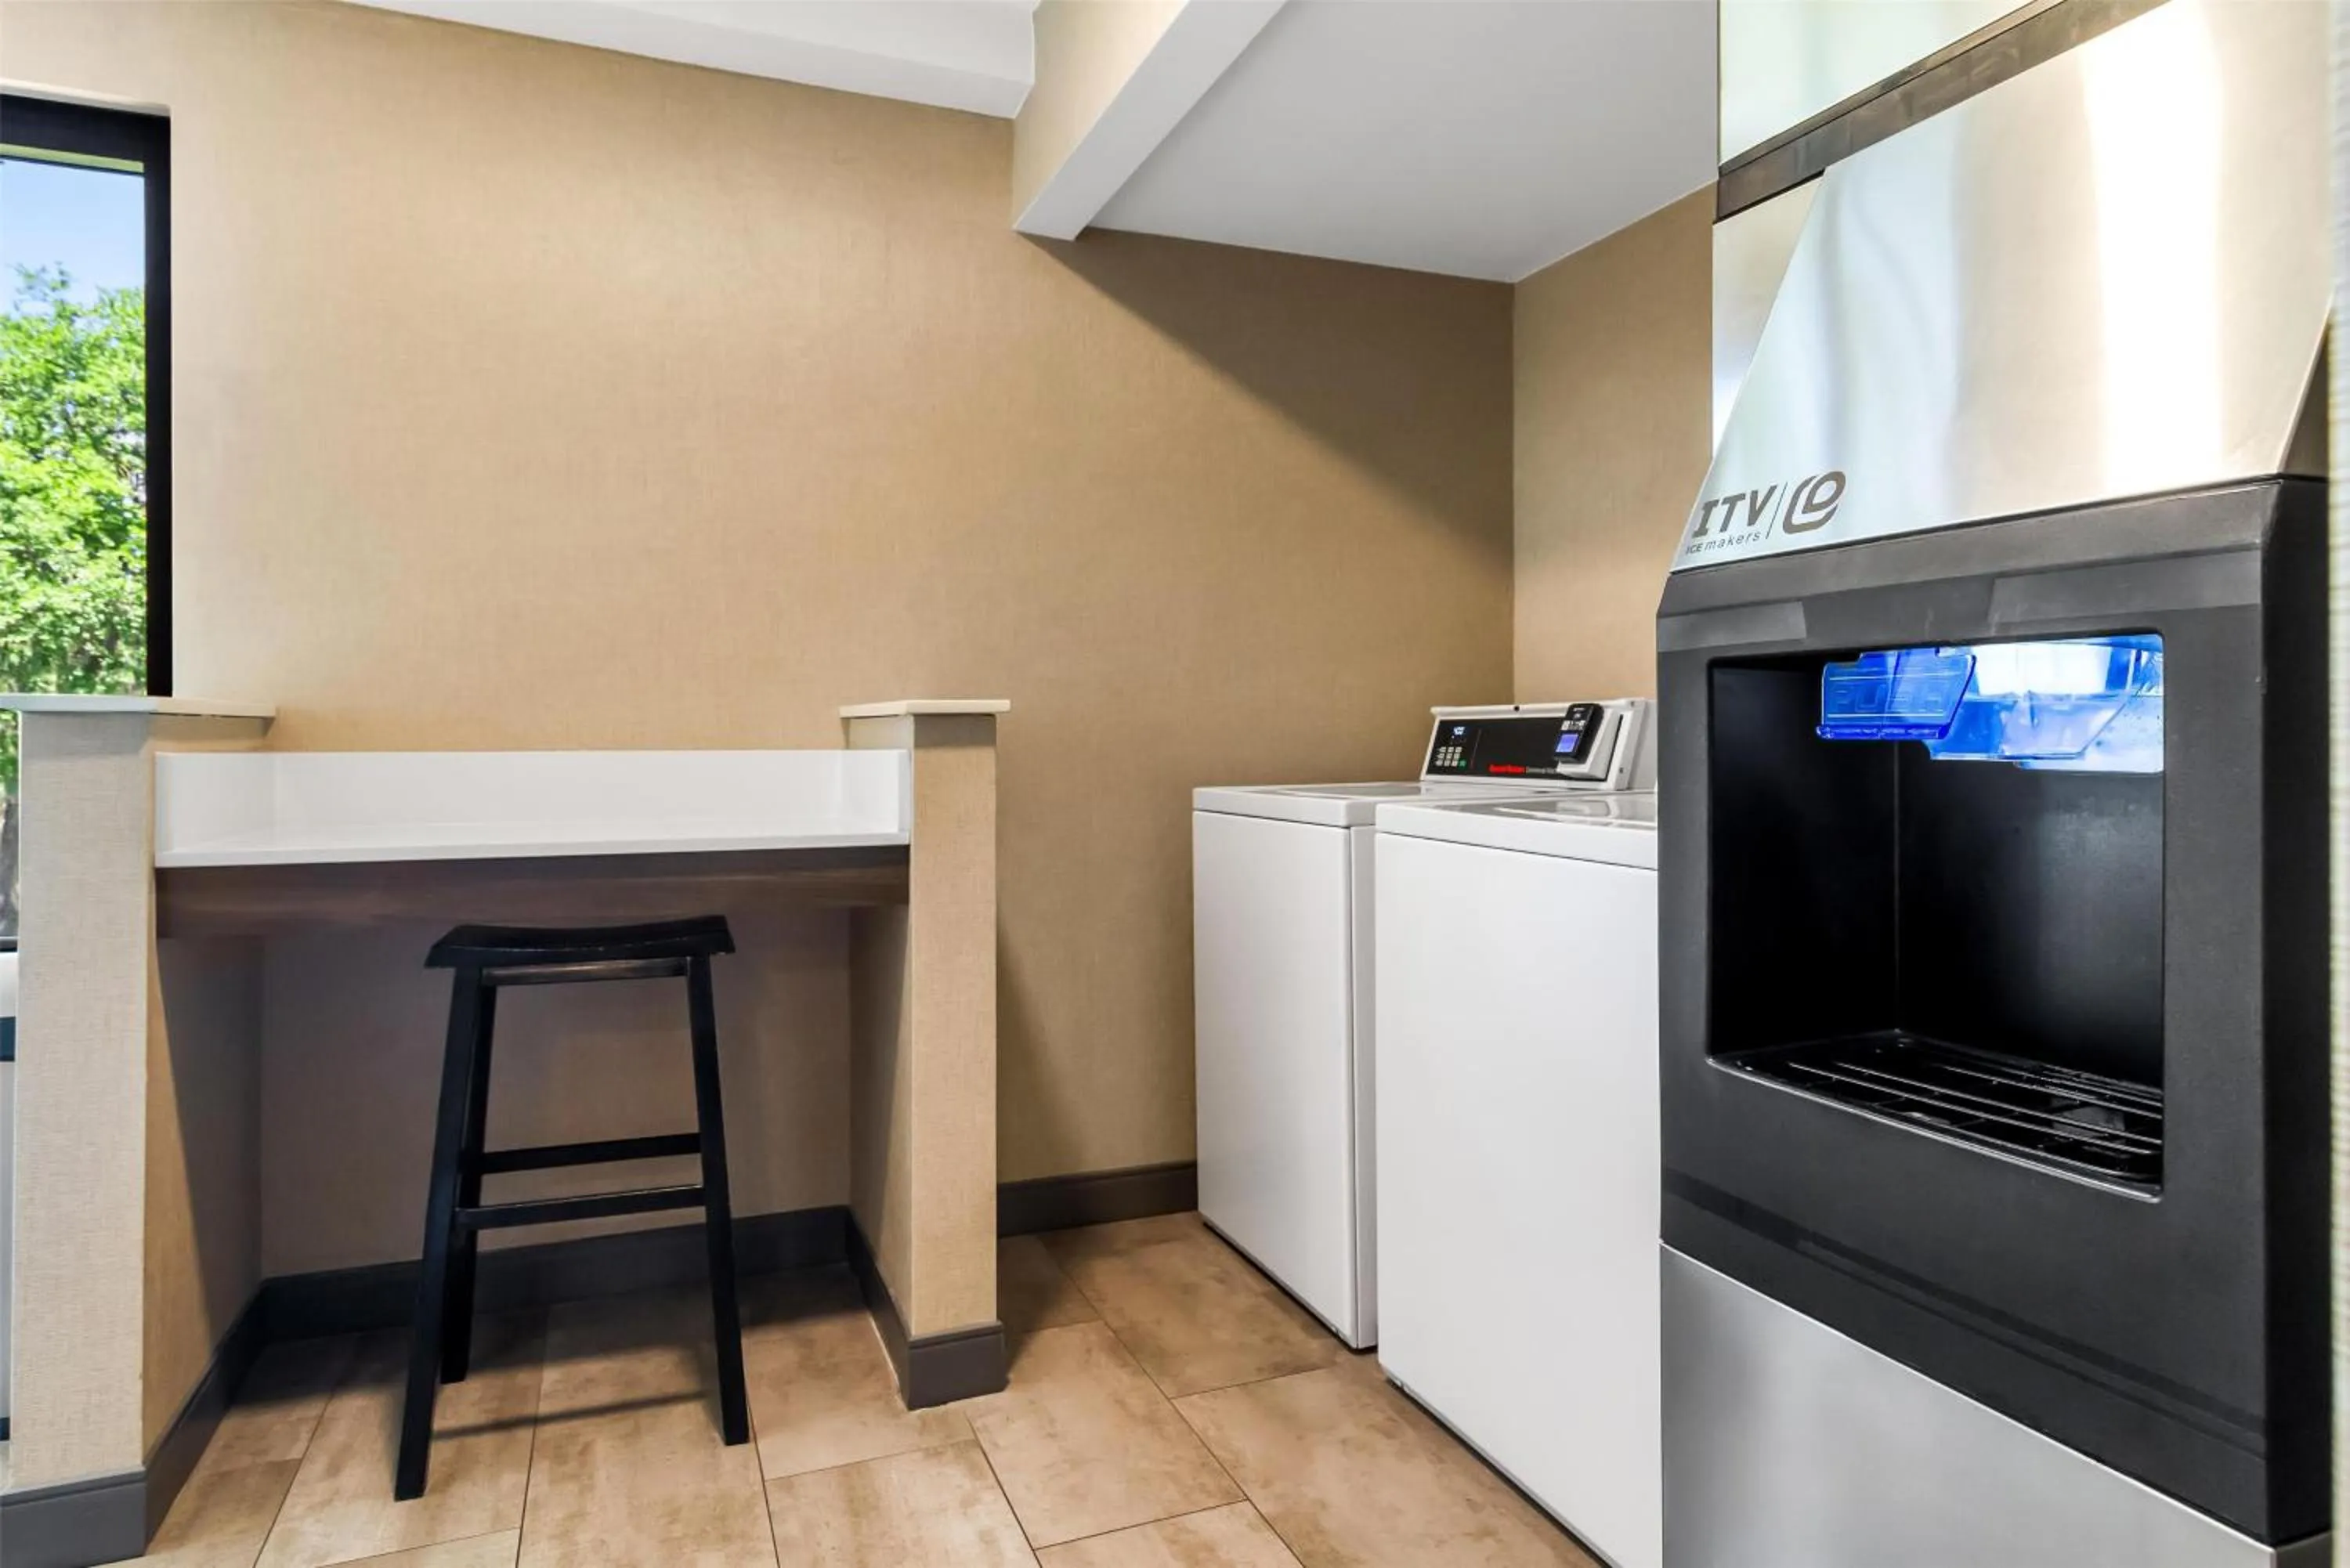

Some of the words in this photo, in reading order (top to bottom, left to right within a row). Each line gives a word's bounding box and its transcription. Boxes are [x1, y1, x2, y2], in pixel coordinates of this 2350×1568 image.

[1691, 485, 1777, 539] ITV
[1685, 543, 1703, 555] ICE
[1704, 532, 1761, 551] makers
